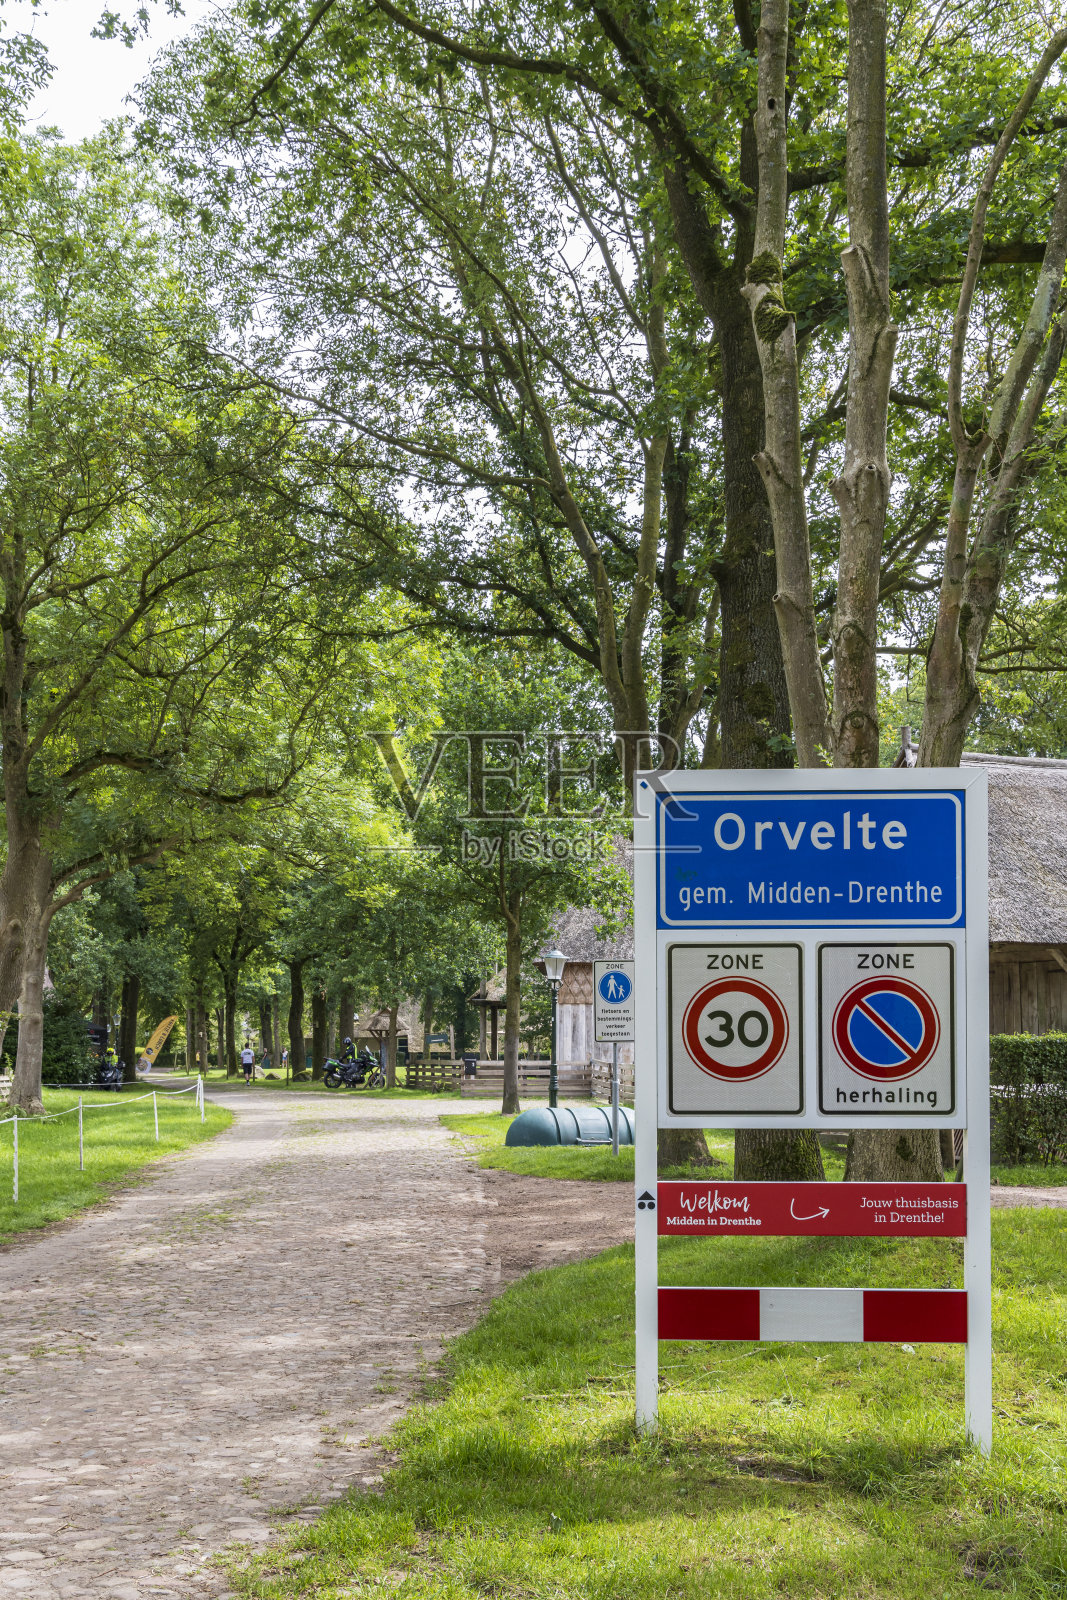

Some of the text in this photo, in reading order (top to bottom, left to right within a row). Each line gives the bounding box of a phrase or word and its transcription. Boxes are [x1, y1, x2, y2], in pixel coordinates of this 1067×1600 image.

[713, 811, 908, 851] Orvelte
[678, 880, 943, 911] gem. Midden-Drenthe
[706, 954, 764, 970] ZONE
[857, 953, 915, 969] ZONE
[704, 1010, 769, 1048] 30
[836, 1087, 937, 1108] herhaling
[680, 1190, 750, 1213] Welkom
[860, 1196, 959, 1208] Jouw thuisbasis
[666, 1217, 762, 1226] Midden in Drenthe
[874, 1211, 945, 1223] in Drenthe!
